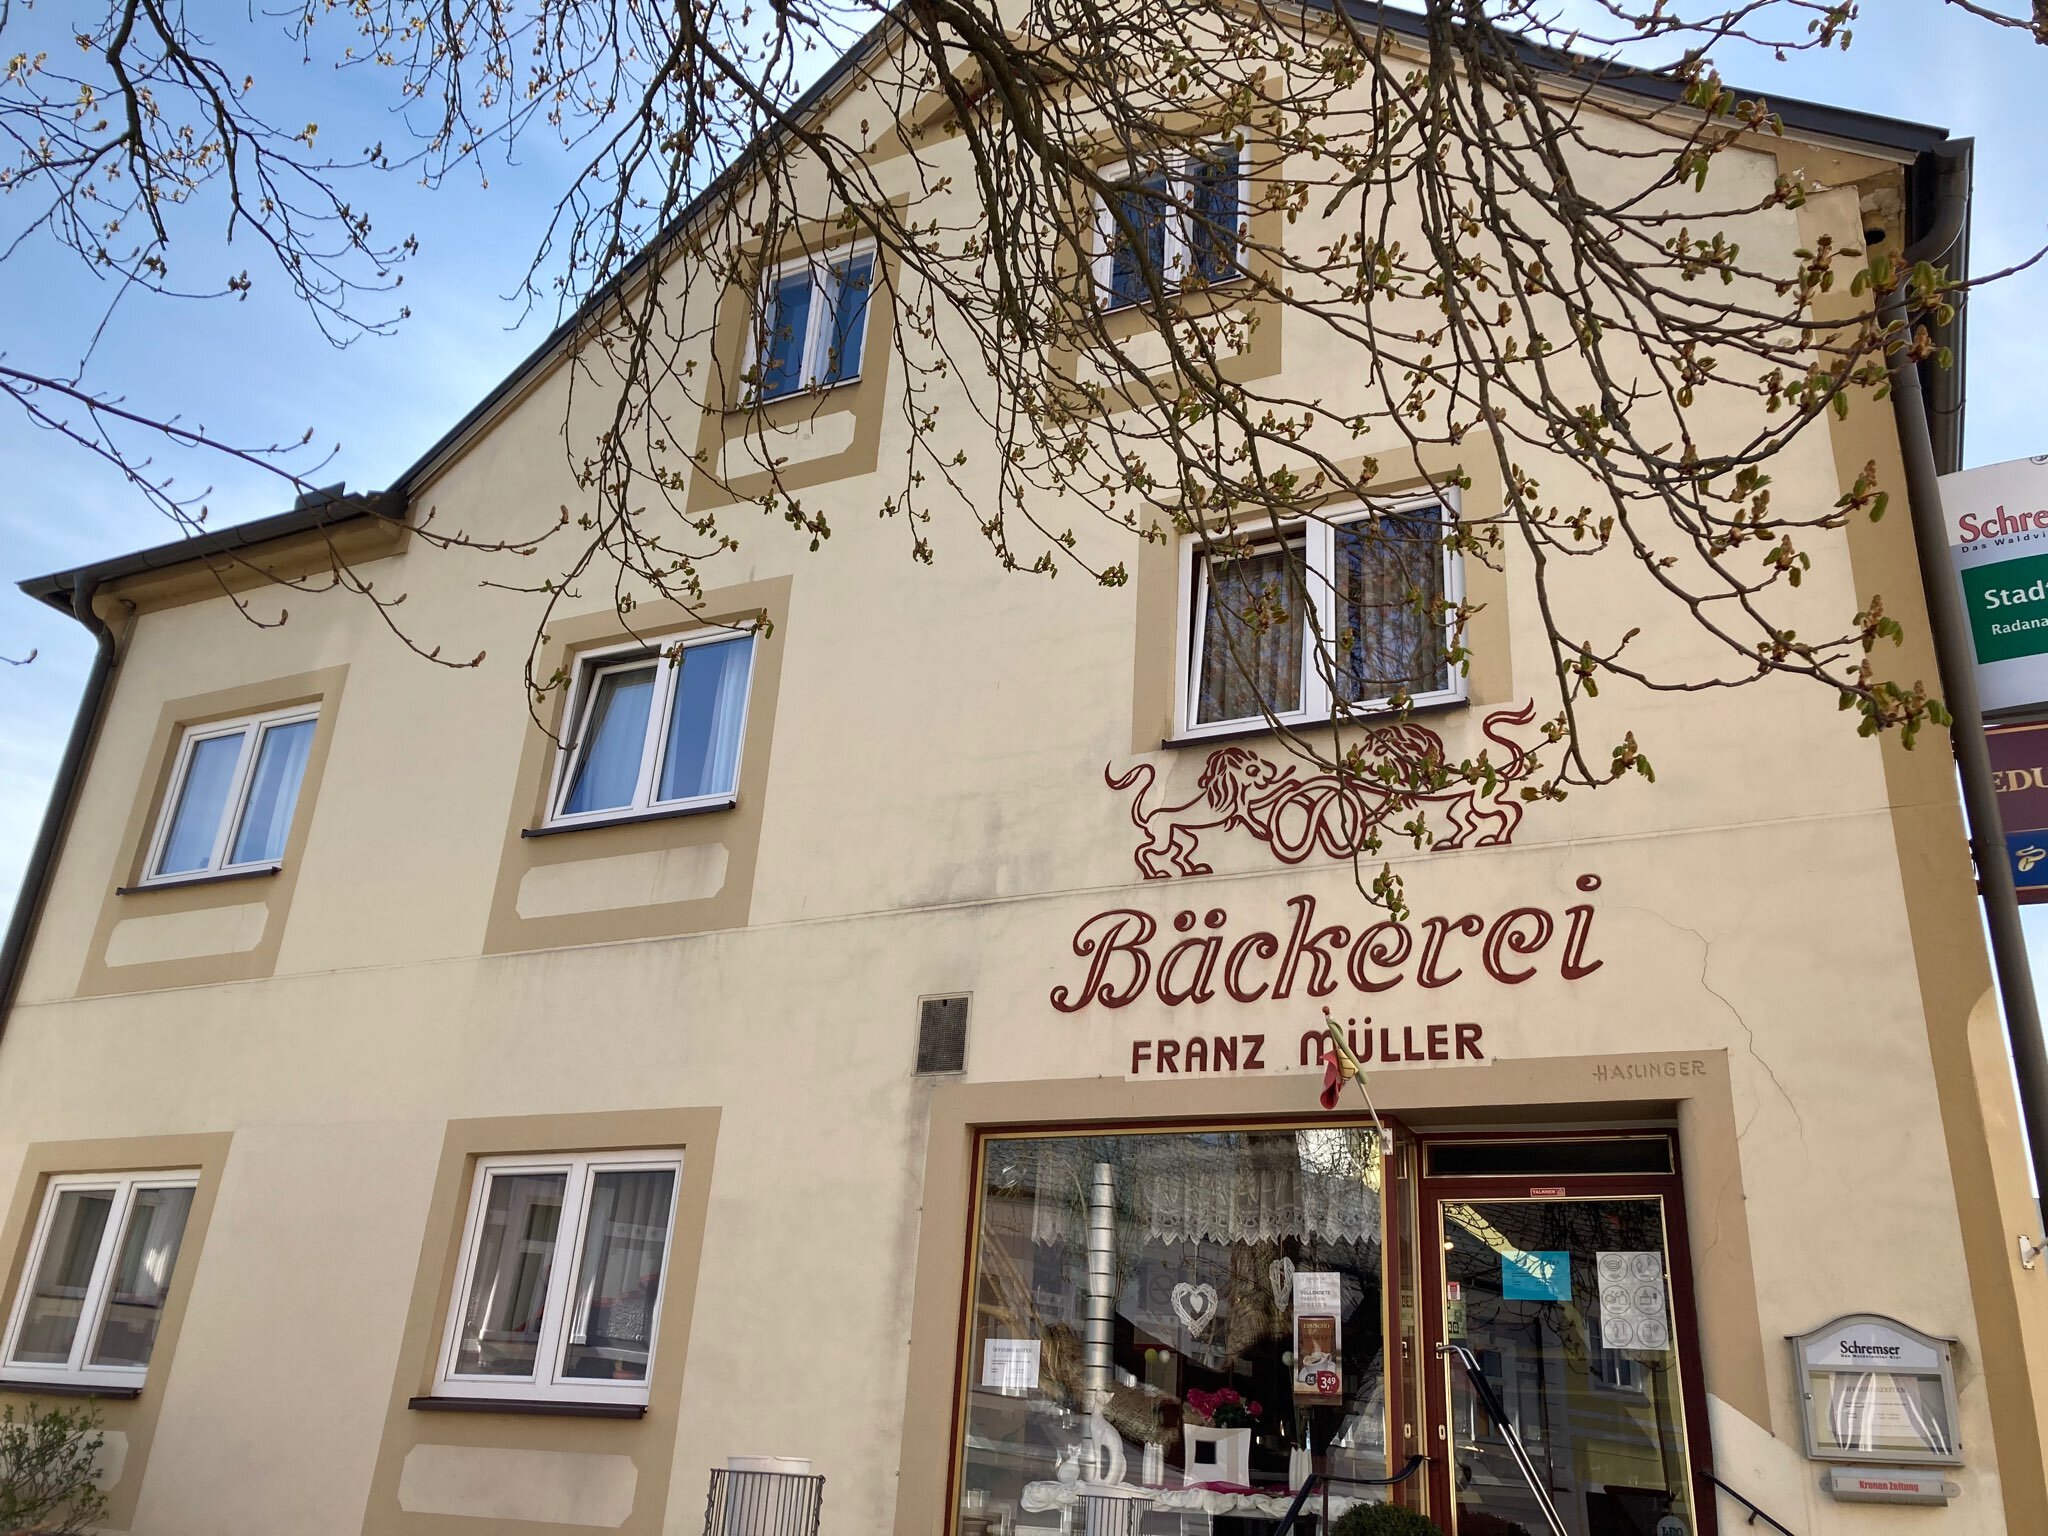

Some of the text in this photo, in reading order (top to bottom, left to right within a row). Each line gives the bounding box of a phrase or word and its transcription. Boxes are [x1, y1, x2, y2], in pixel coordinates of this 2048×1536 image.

[1961, 543, 1987, 553] Das
[1984, 579, 2048, 609] Stad
[1049, 874, 1604, 1013] Bäckerei
[1131, 1016, 1485, 1074] FRANZ MÜLLER
[1592, 1060, 1706, 1081] HASLINGER
[1840, 1340, 1900, 1355] Schremser
[1859, 1480, 1919, 1492] Kronen Zeitung
